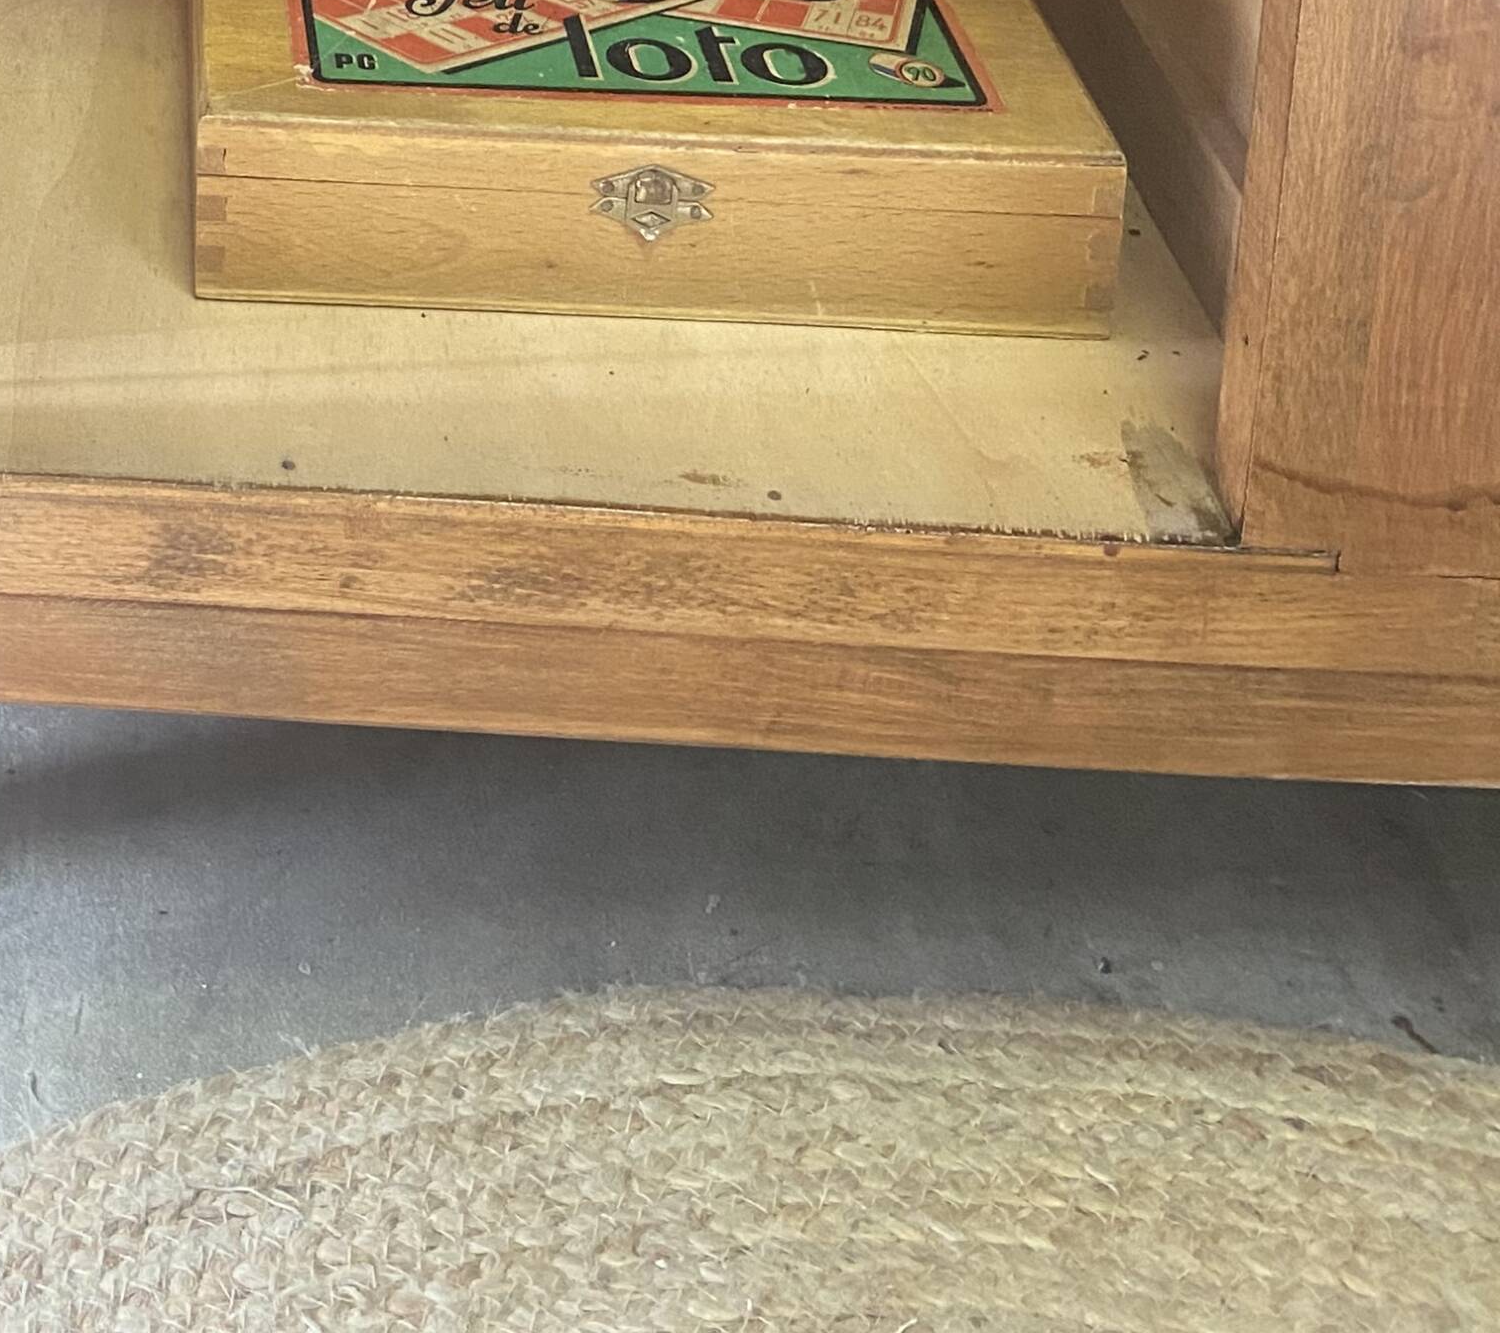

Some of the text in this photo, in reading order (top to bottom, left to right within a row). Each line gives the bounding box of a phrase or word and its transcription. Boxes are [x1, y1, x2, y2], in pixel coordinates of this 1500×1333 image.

[492, 12, 544, 35] de
[855, 15, 887, 32] 84
[562, 13, 832, 85] loto
[908, 66, 937, 82] 90
